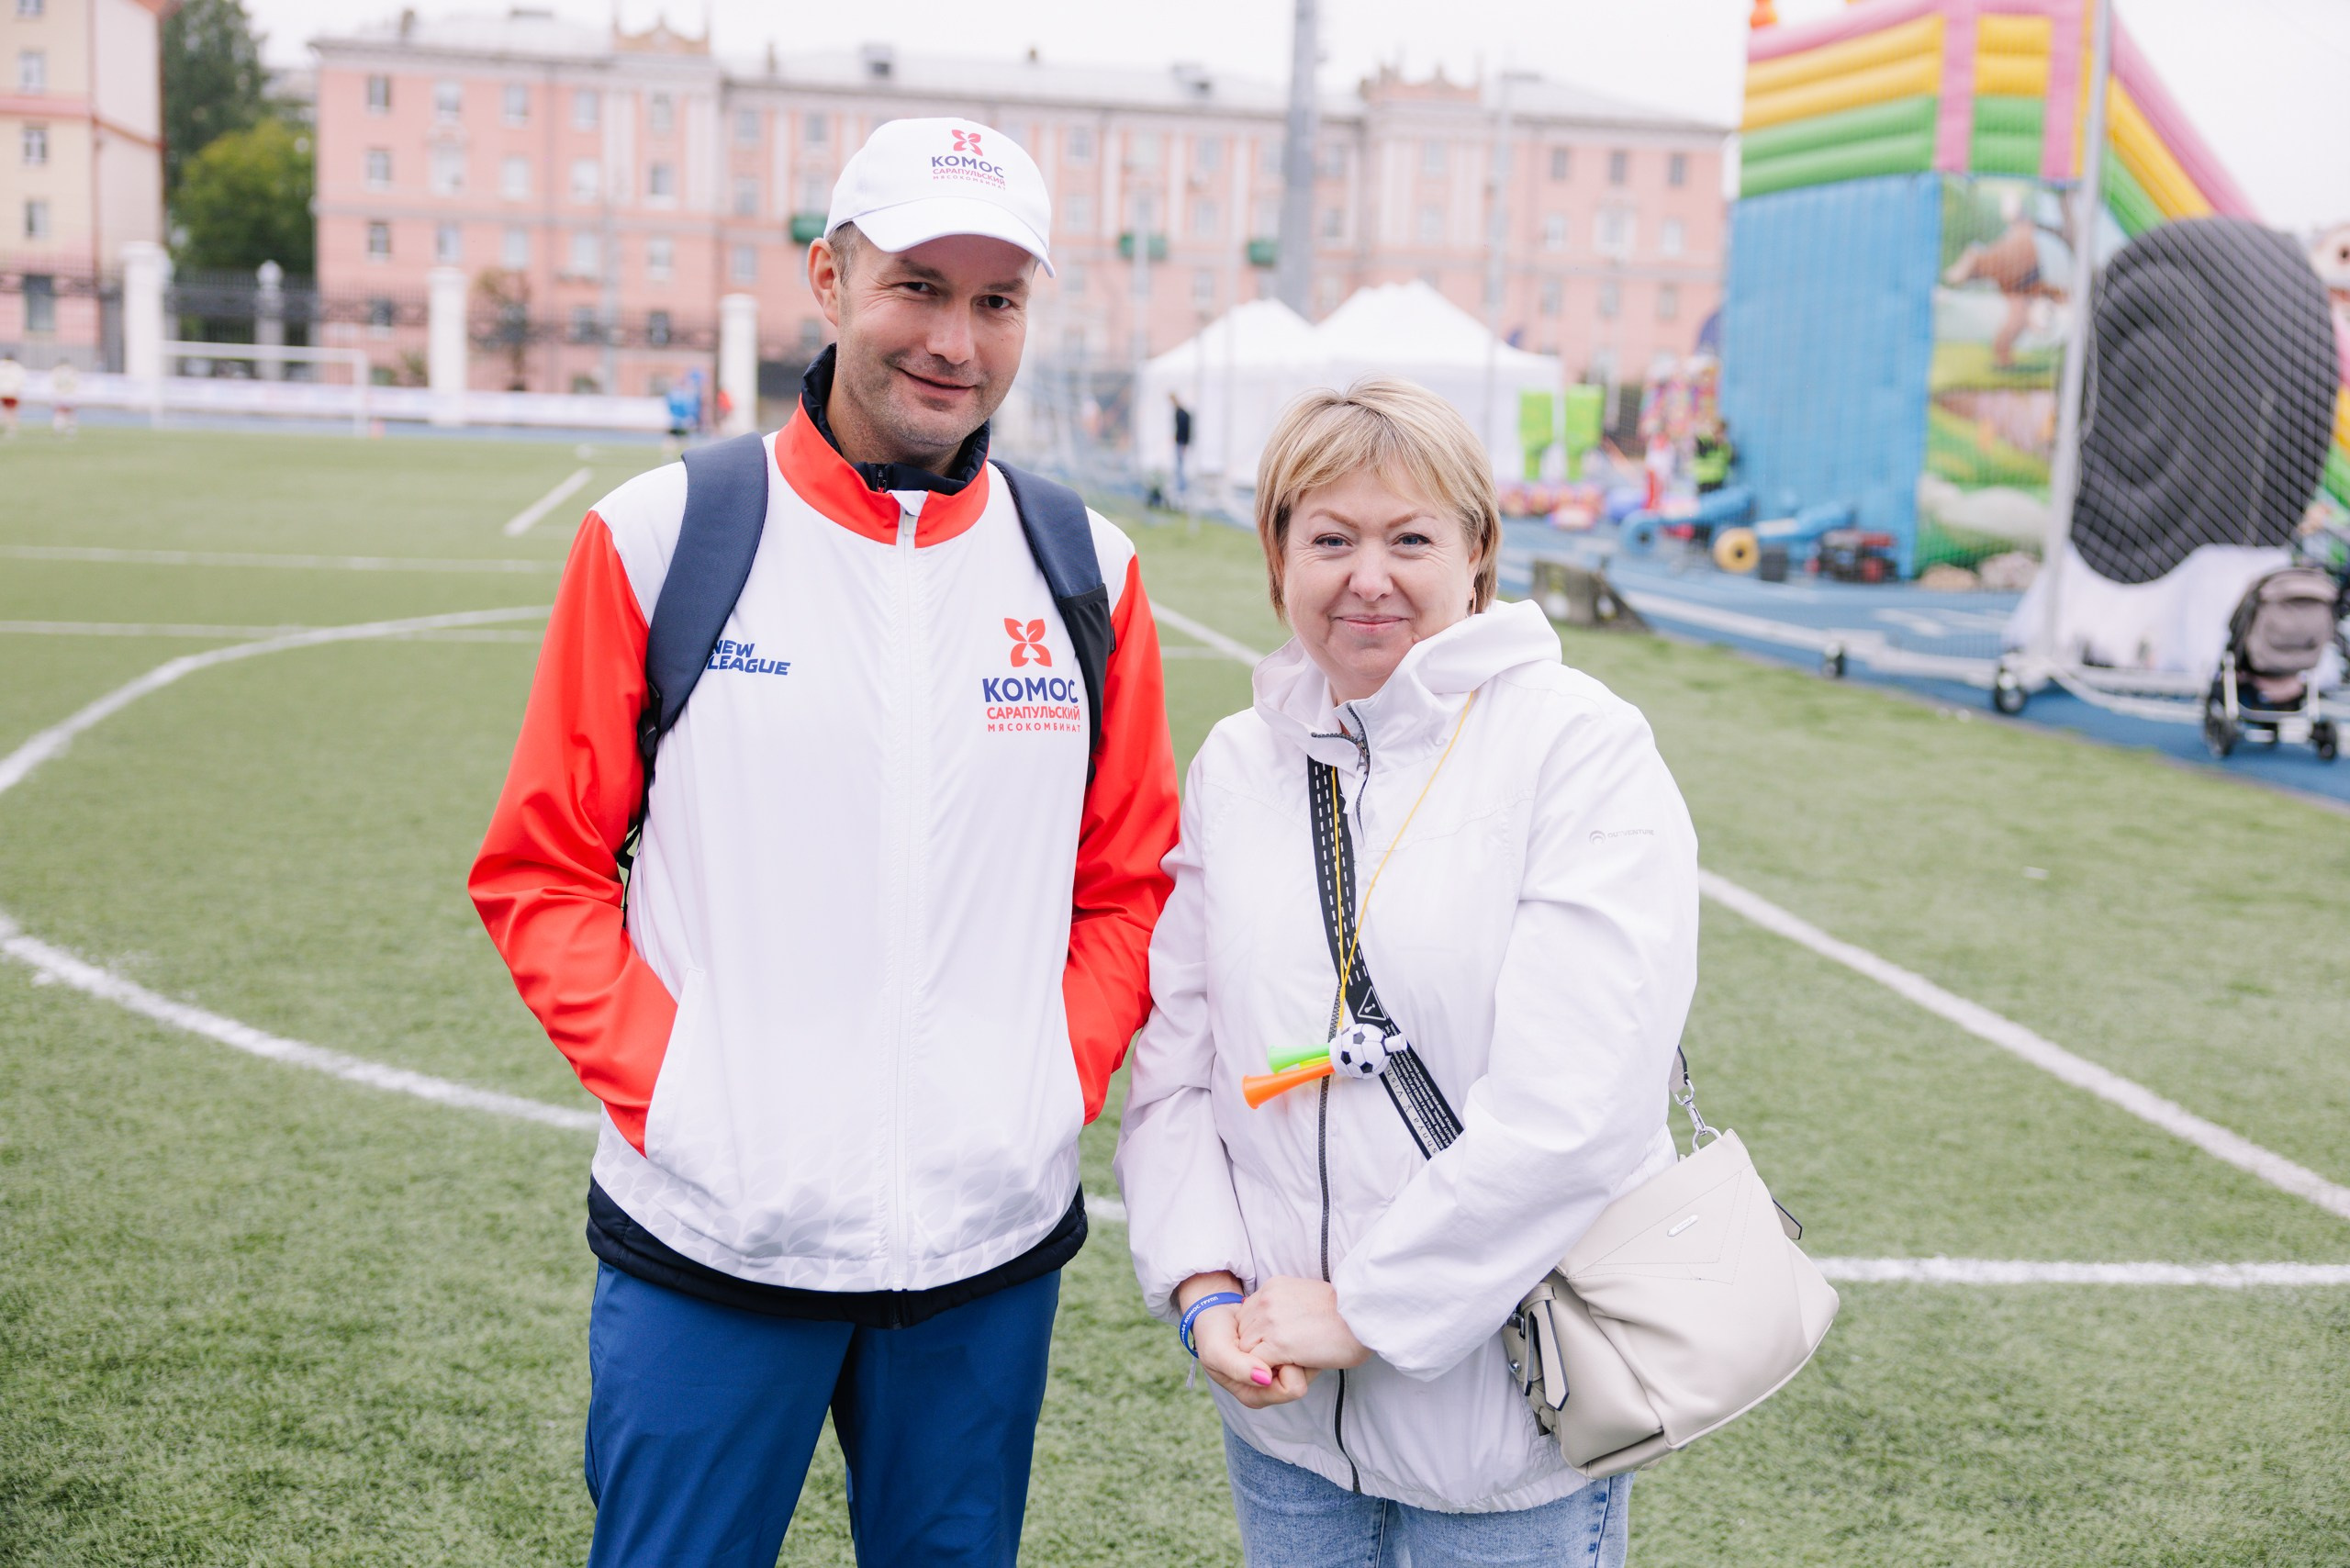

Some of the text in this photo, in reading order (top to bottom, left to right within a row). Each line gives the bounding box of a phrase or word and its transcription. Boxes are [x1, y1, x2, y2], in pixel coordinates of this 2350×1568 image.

[931, 155, 1004, 179] КОМОС
[933, 168, 1006, 186] САРАПУЛЬСКИЙ
[713, 639, 755, 658] NEW
[707, 654, 791, 676] LEAGUE
[981, 677, 1079, 703] КОМОС
[986, 705, 1080, 721] САРАПУЛЬСКИЙ
[987, 722, 1081, 733] МЯСОКОМБИНАТ
[1184, 1304, 1201, 1324] КОМОС
